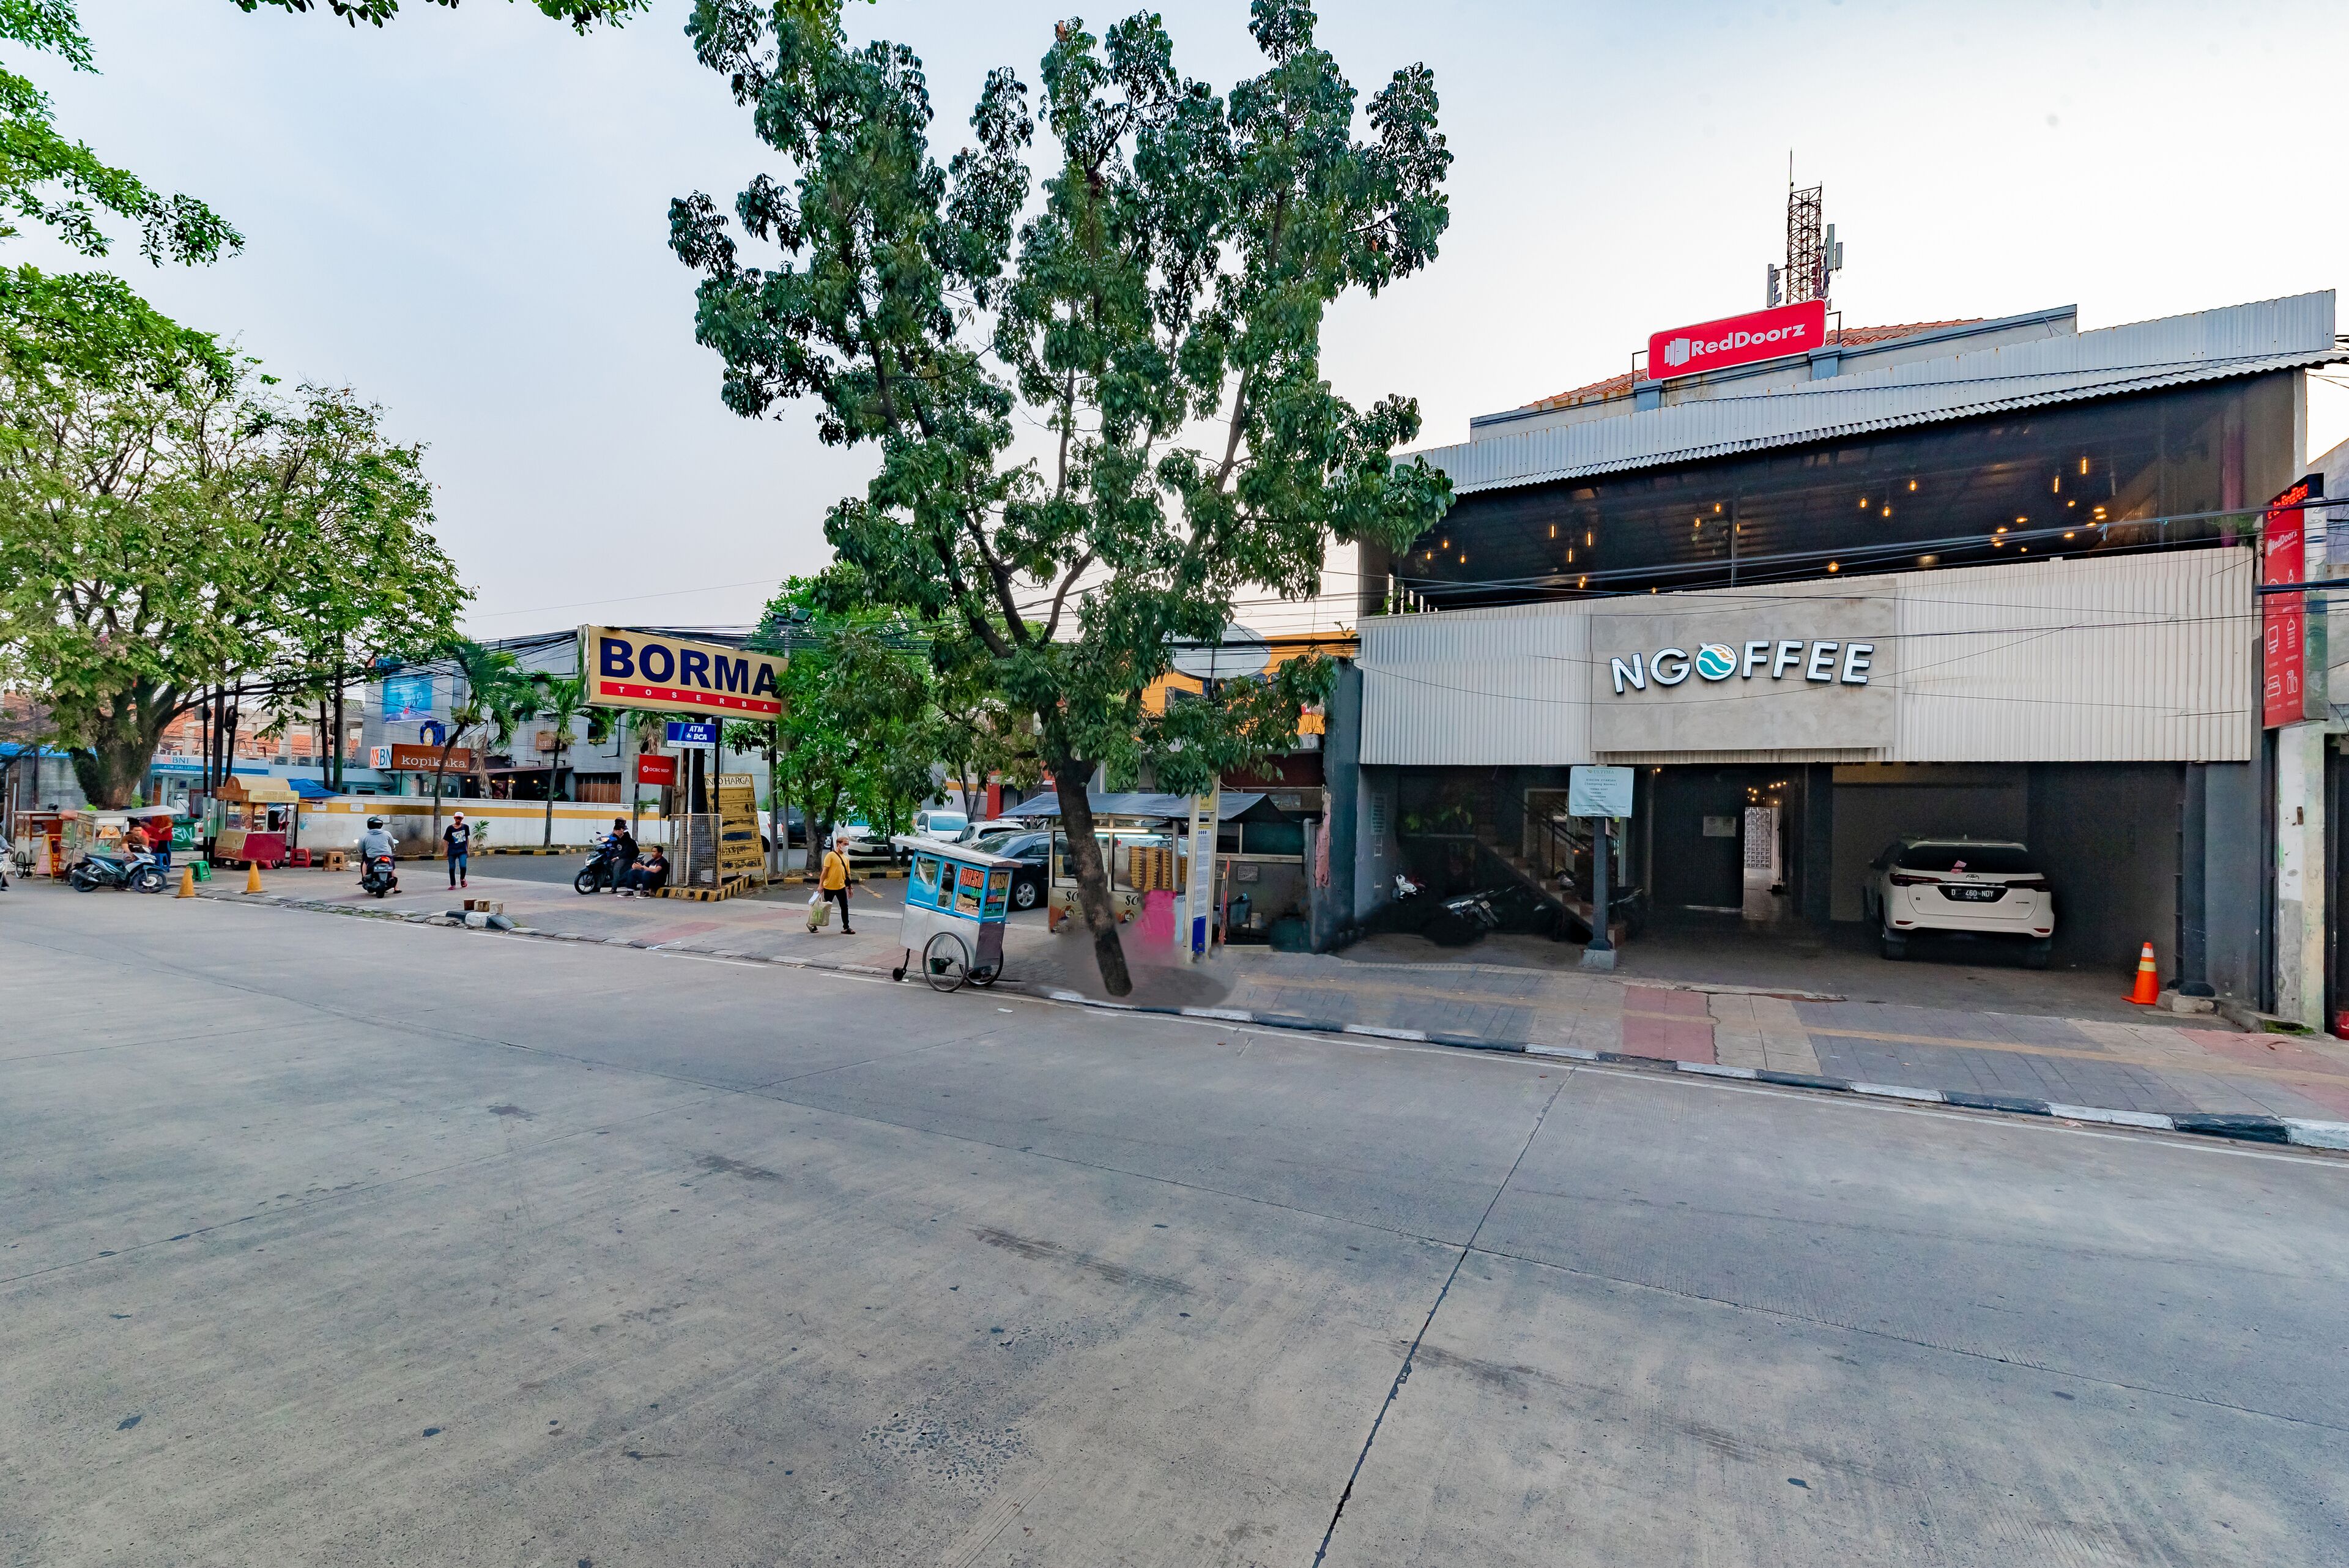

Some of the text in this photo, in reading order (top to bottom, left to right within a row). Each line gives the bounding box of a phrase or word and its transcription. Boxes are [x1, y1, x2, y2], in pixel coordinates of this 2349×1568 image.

[1691, 323, 1806, 357] RedDoorz
[599, 636, 781, 699] BORMA
[618, 686, 769, 711] TOSERBA
[379, 748, 392, 766] BN
[705, 776, 751, 786] INO HARGA
[959, 868, 985, 888] BASO
